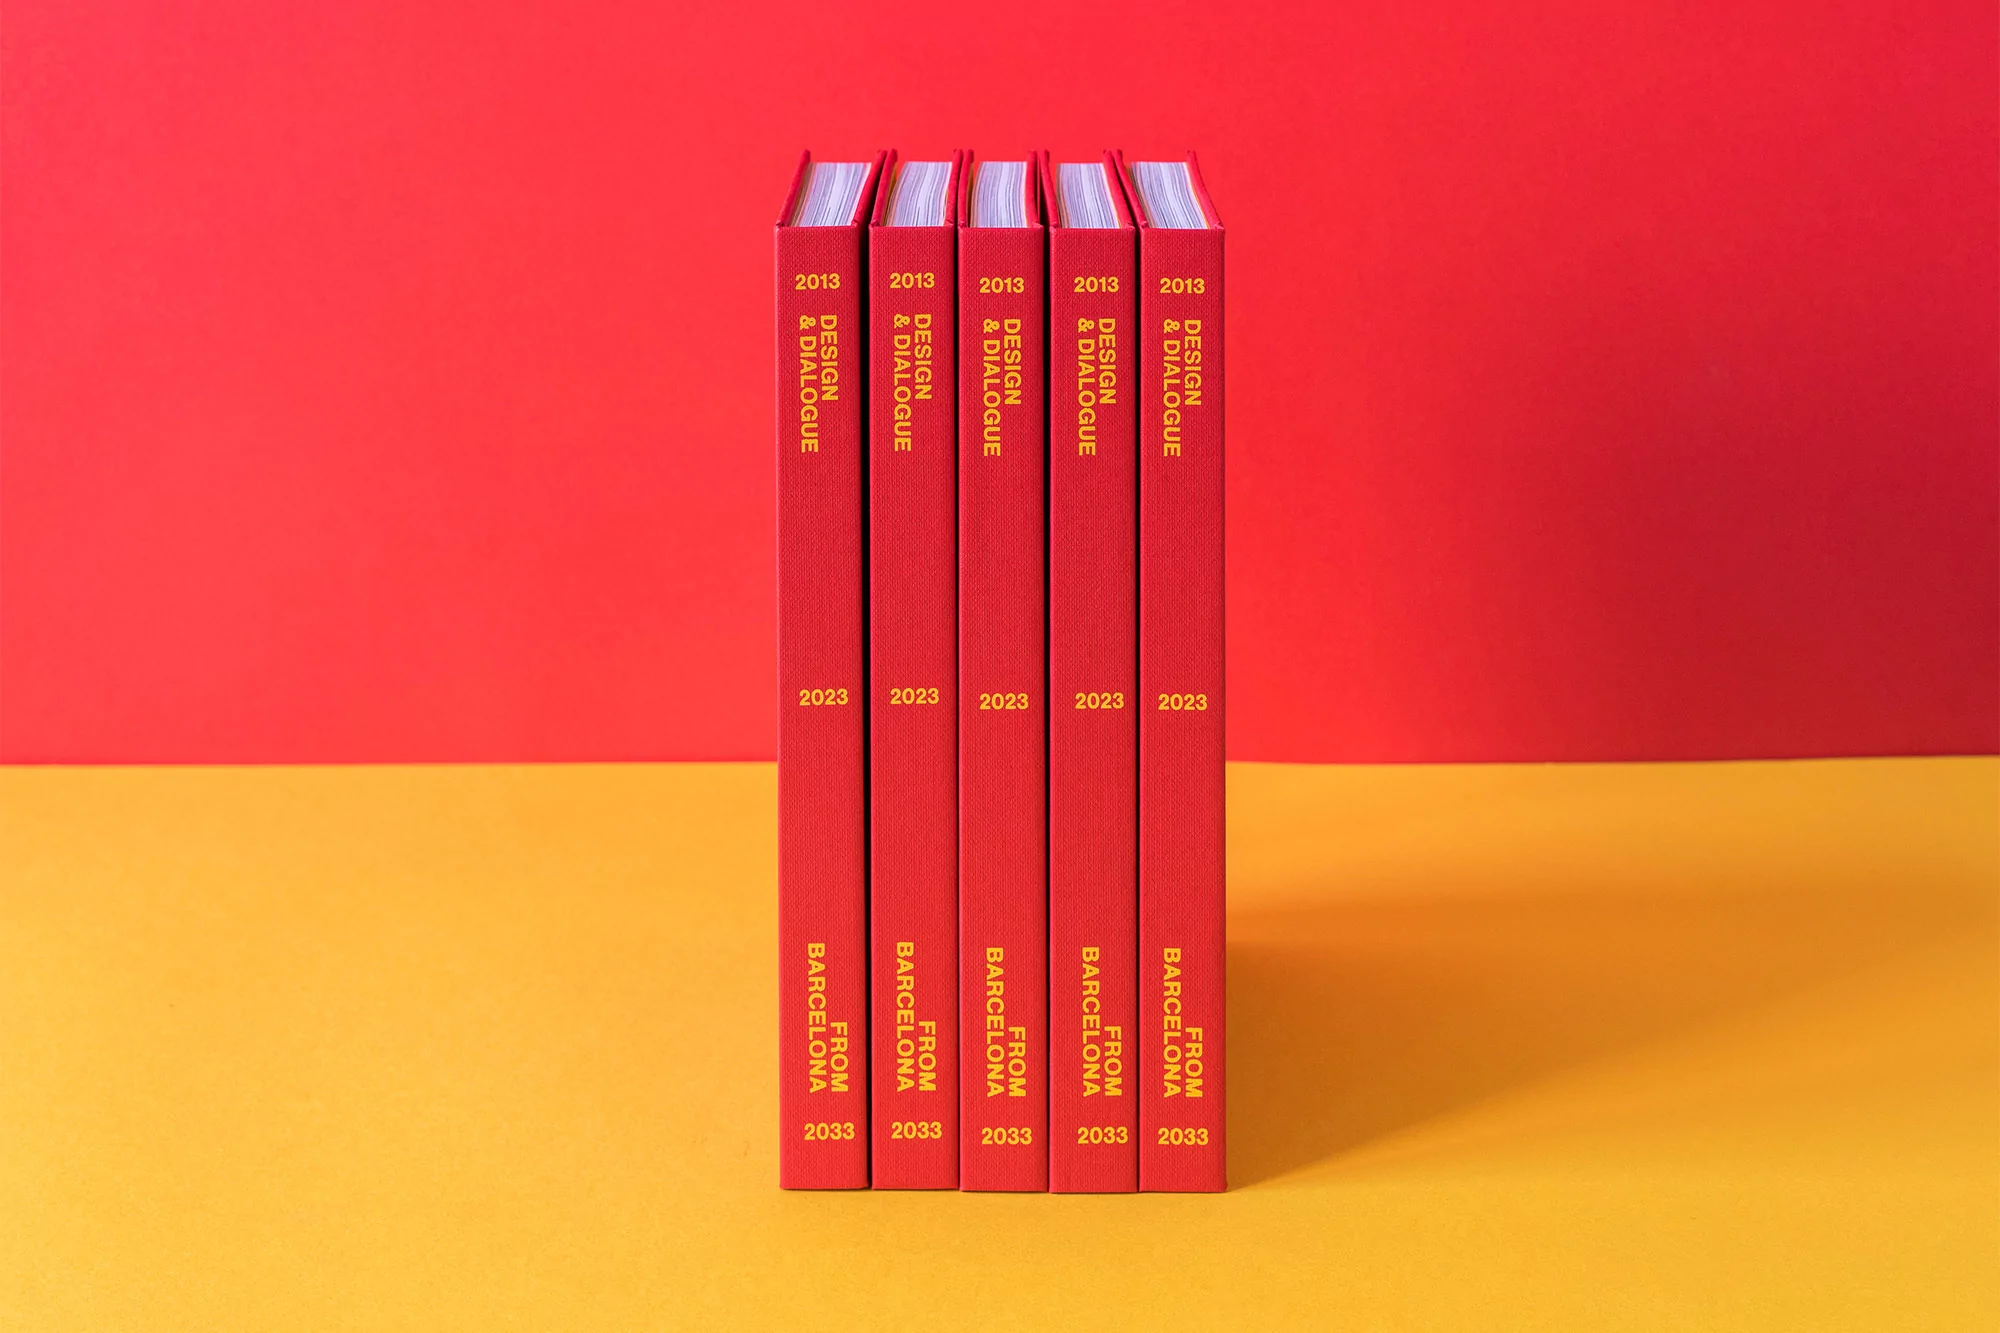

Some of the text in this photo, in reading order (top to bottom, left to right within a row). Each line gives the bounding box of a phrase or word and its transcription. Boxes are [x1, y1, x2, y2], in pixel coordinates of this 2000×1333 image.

[795, 273, 841, 291] 2013
[890, 272, 935, 289] 2013
[979, 277, 1025, 294] 2013
[1074, 276, 1119, 293] 2013
[1160, 277, 1205, 295] 2013
[799, 315, 819, 453] & DIALOGUE
[820, 315, 839, 401] DESIGN
[893, 313, 912, 451] & DIALOGUE
[914, 313, 932, 399] DESIGN
[983, 318, 1001, 457] & DIALOGUE
[1003, 319, 1022, 405] DESIGN
[1077, 317, 1096, 456] & DIALOGUE
[1098, 318, 1117, 404] DESIGN
[1163, 319, 1181, 457] & DIALOGUE
[1183, 319, 1202, 405] DESIGN
[799, 687, 849, 706] 2023
[890, 687, 939, 705] 2023
[979, 692, 1029, 710] 2023
[1075, 691, 1125, 709] 2023
[1158, 693, 1208, 711] 2023
[807, 943, 827, 1093] BARCELONA
[896, 941, 915, 1092] BARCELONA
[985, 947, 1005, 1097] BARCELONA
[1081, 946, 1101, 1097] BARCELONA
[1163, 947, 1182, 1098] BARCELONA
[829, 1021, 849, 1092] FROM
[917, 1021, 937, 1091] FROM
[1007, 1026, 1027, 1097] FROM
[1103, 1025, 1123, 1097] FROM
[1184, 1027, 1203, 1098] FROM
[804, 1121, 855, 1141] 2033
[891, 1121, 942, 1139] 2033
[981, 1127, 1033, 1145] 2033
[1077, 1125, 1129, 1145] 2033
[1157, 1127, 1209, 1146] 2033
